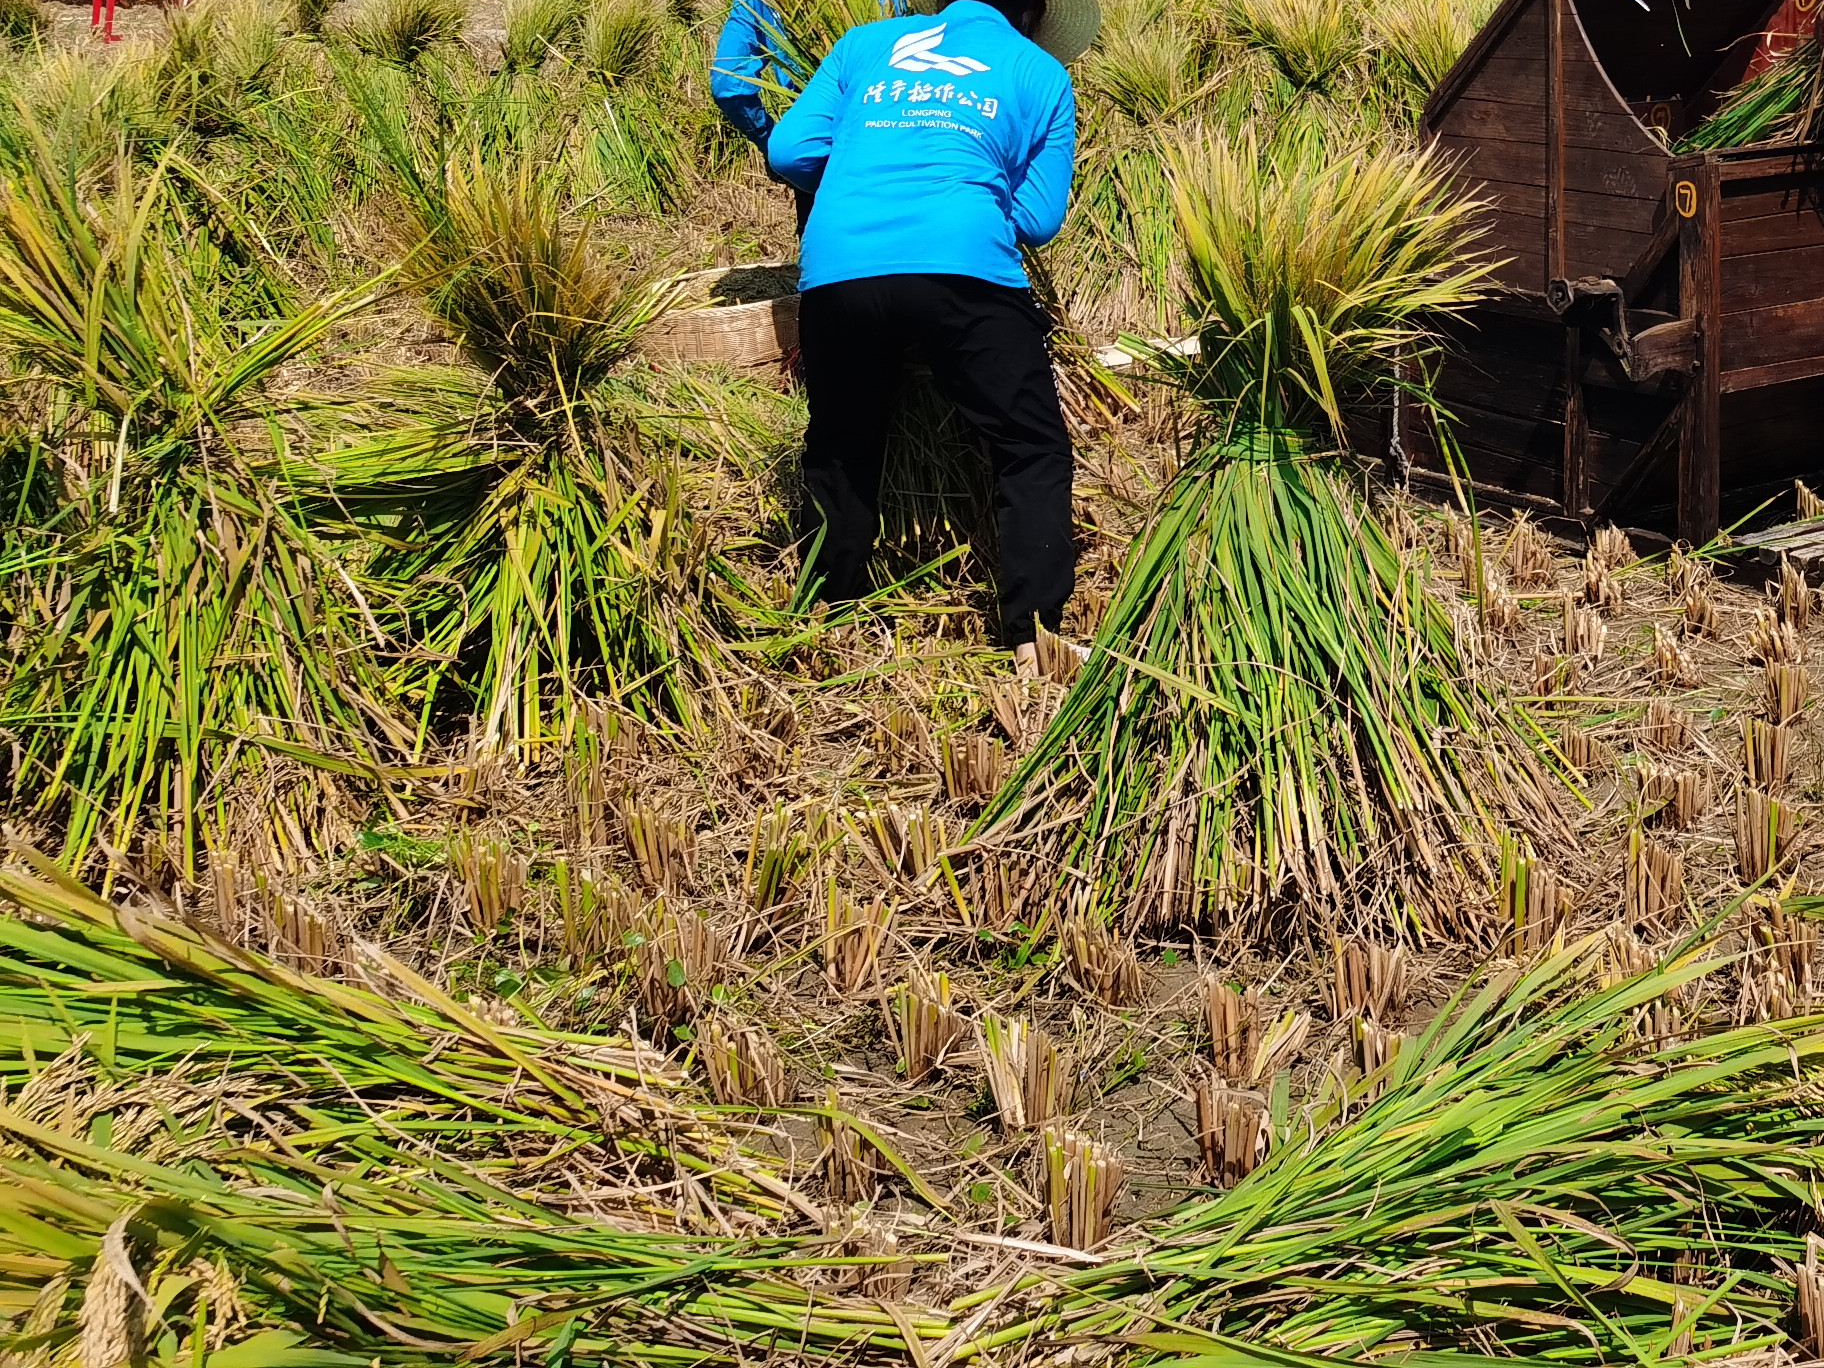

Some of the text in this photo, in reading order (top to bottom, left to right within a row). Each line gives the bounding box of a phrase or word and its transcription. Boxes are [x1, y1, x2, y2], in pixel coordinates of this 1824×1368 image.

[901, 109, 952, 118] LONGPING
[864, 118, 984, 139] PADDY CULTIVATION PARK
